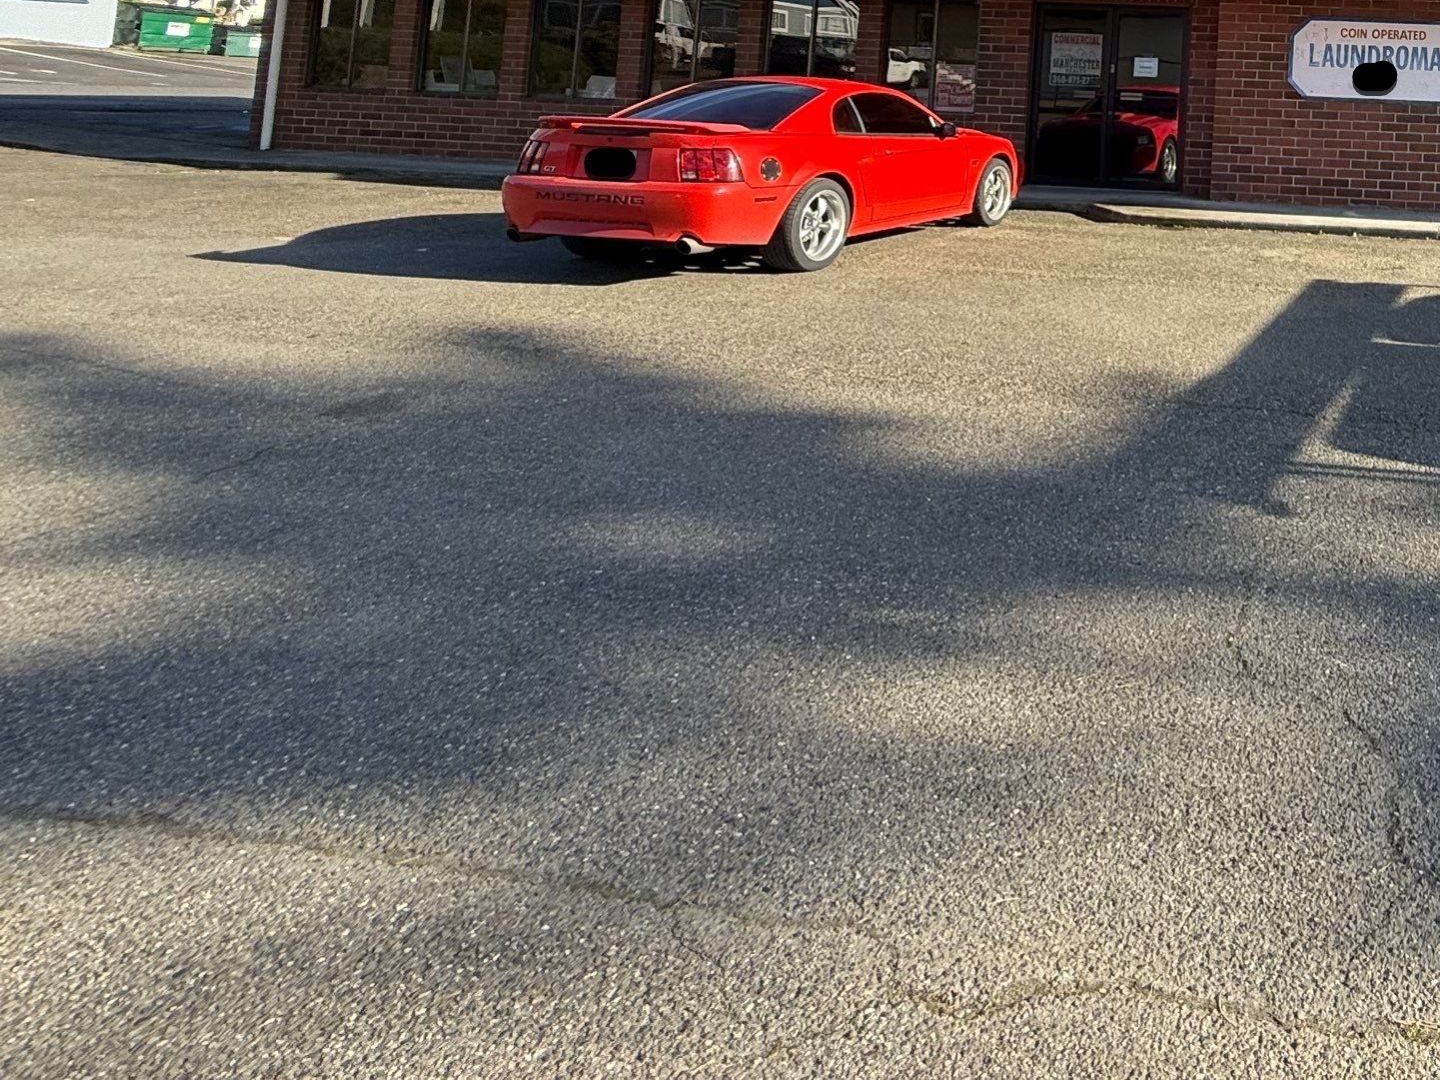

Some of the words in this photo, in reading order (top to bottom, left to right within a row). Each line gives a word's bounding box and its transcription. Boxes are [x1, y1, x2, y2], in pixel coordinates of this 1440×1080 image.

[1054, 34, 1100, 46] COMMERCIAL
[1340, 27, 1367, 39] COIN
[1371, 28, 1427, 41] OPERATED
[544, 165, 556, 173] GT
[535, 191, 645, 206] MUSTANG
